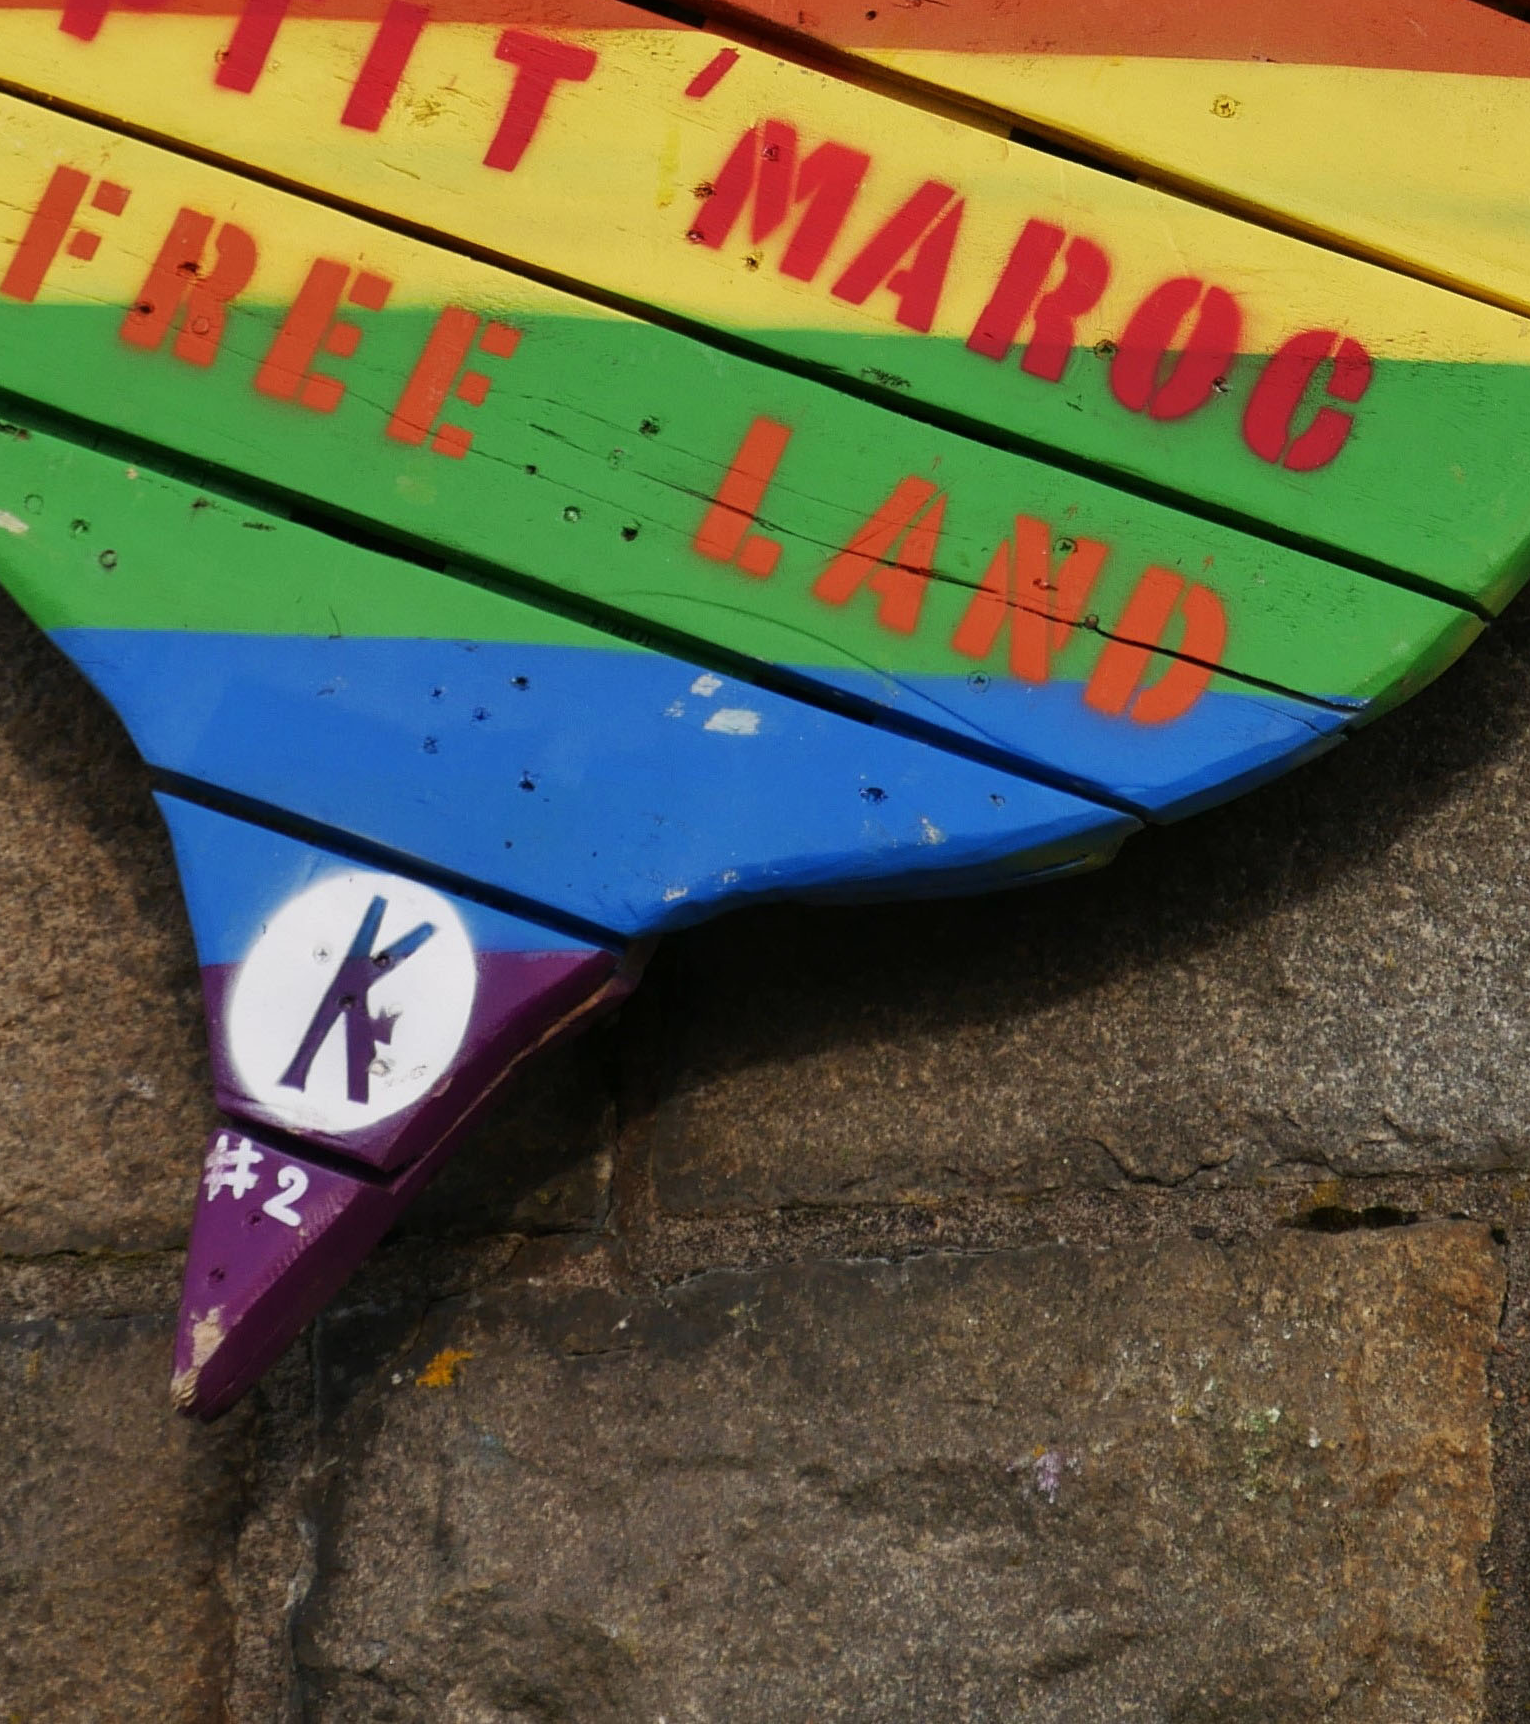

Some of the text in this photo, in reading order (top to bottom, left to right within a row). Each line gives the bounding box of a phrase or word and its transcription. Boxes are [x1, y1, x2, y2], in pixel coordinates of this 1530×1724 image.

[0, 164, 1230, 726] FREE LAND
[277, 895, 437, 1104] K
[204, 1135, 308, 1227] #2
